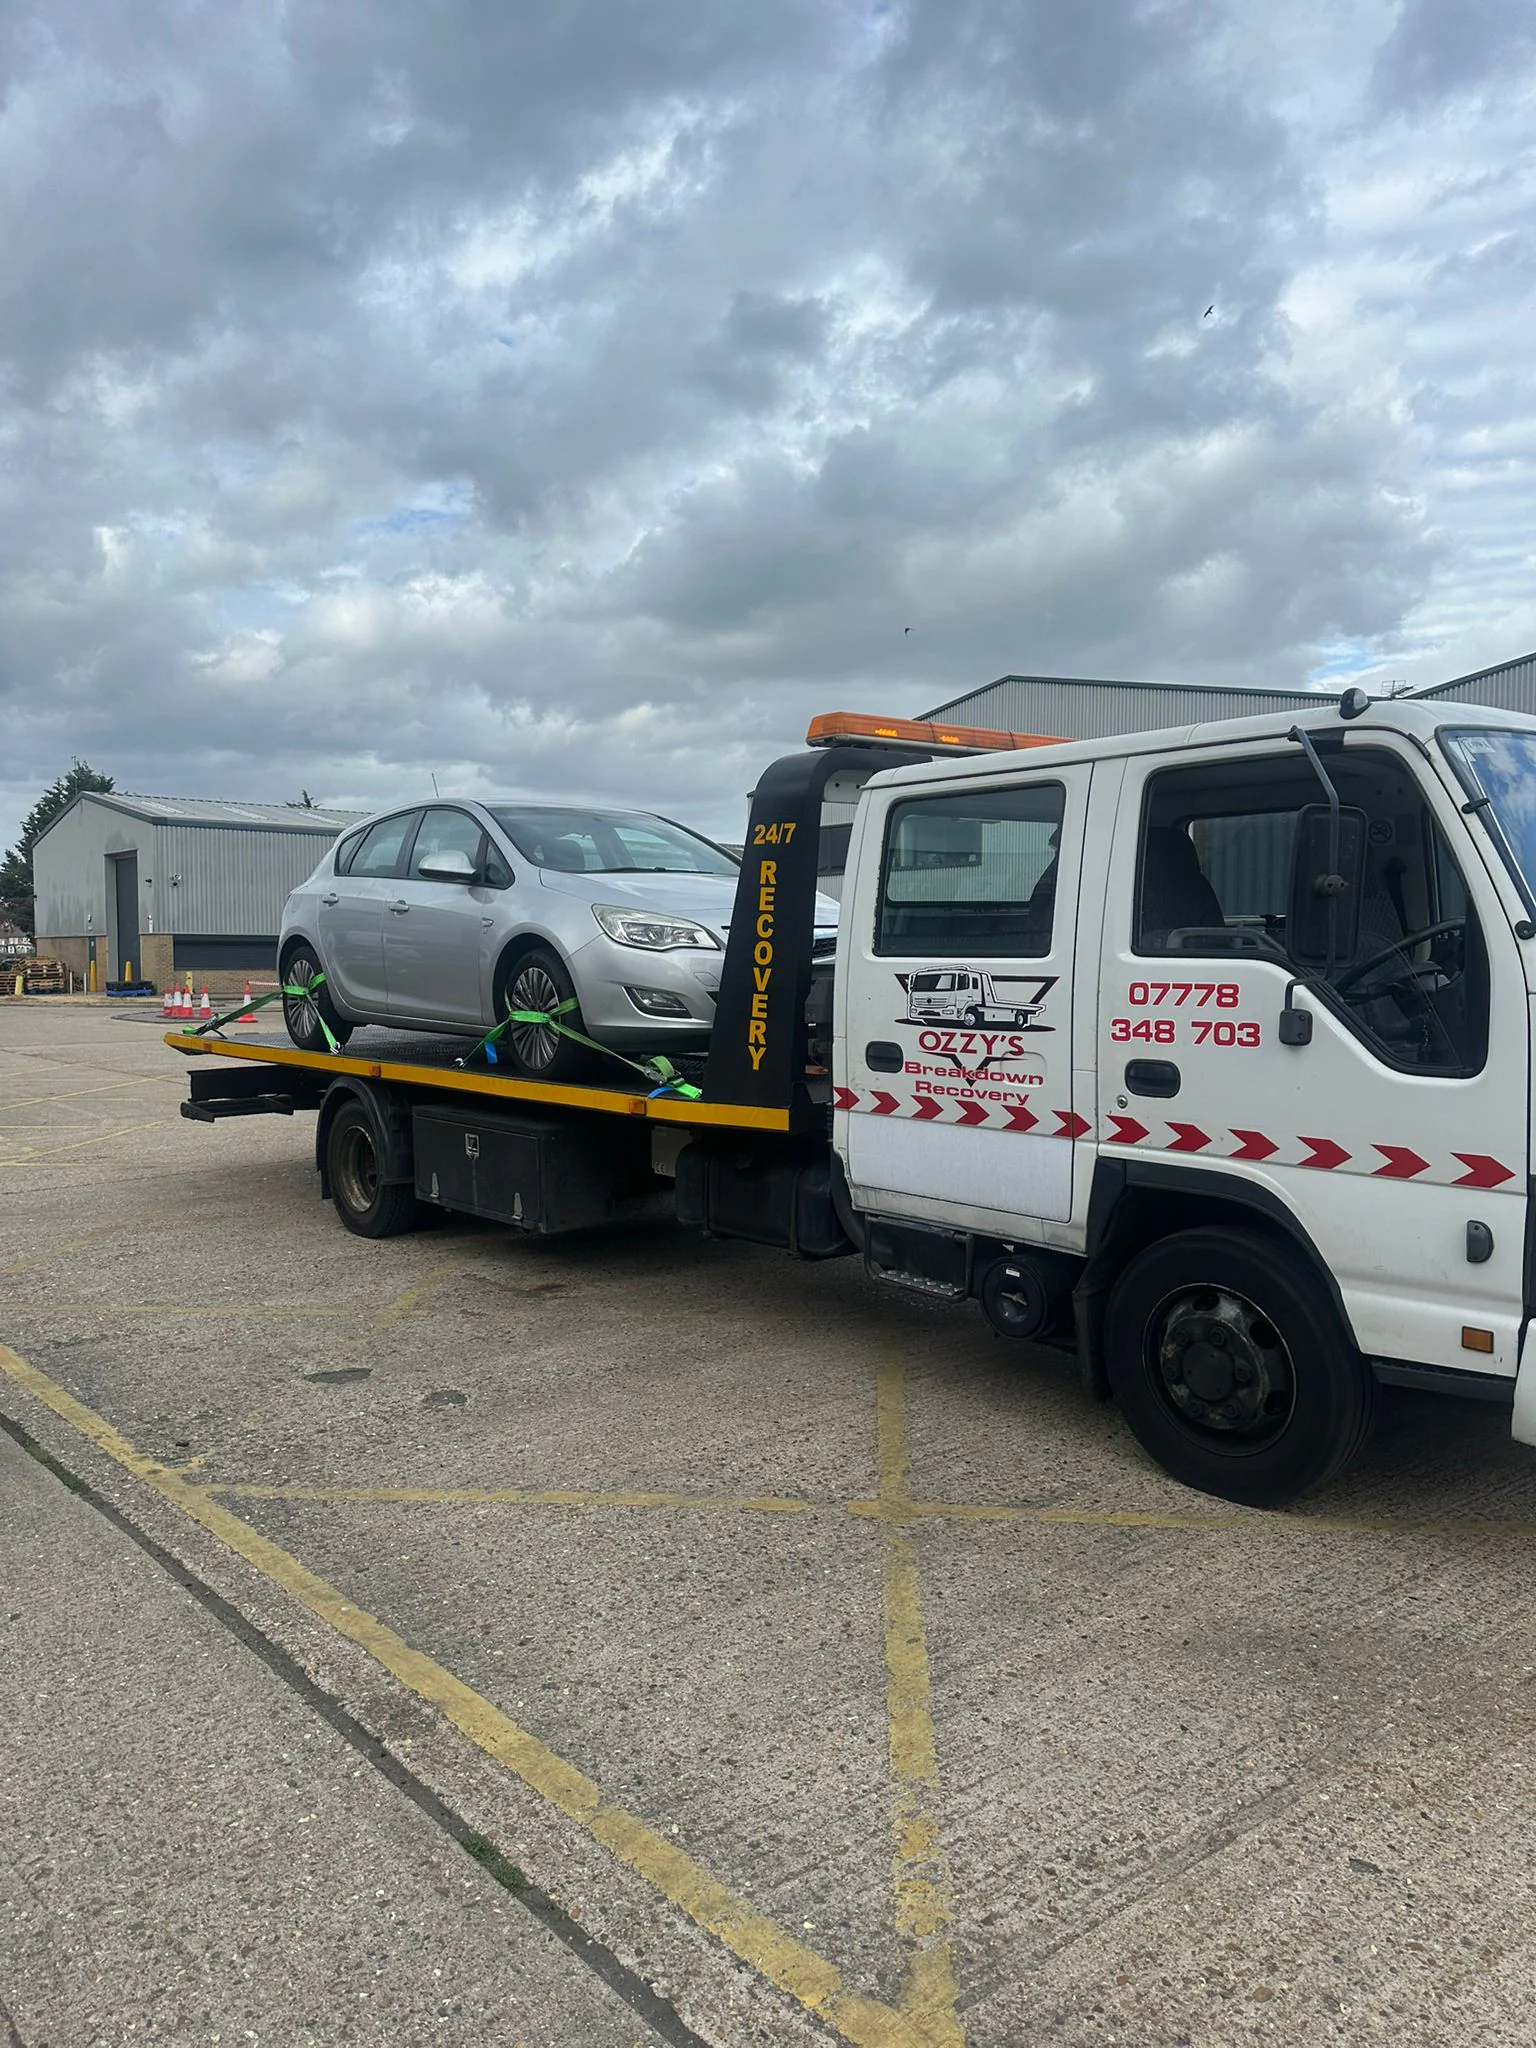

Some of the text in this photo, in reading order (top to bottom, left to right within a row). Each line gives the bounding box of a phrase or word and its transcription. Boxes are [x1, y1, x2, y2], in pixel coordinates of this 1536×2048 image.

[753, 822, 797, 845] 24/7
[748, 860, 777, 1071] RECOVERY
[1128, 982, 1240, 1008] 07778
[918, 1030, 1025, 1056] OZZY'S
[1111, 1018, 1261, 1047] 348 703
[904, 1061, 1044, 1086] Breakdown
[915, 1080, 1030, 1106] Recovery
